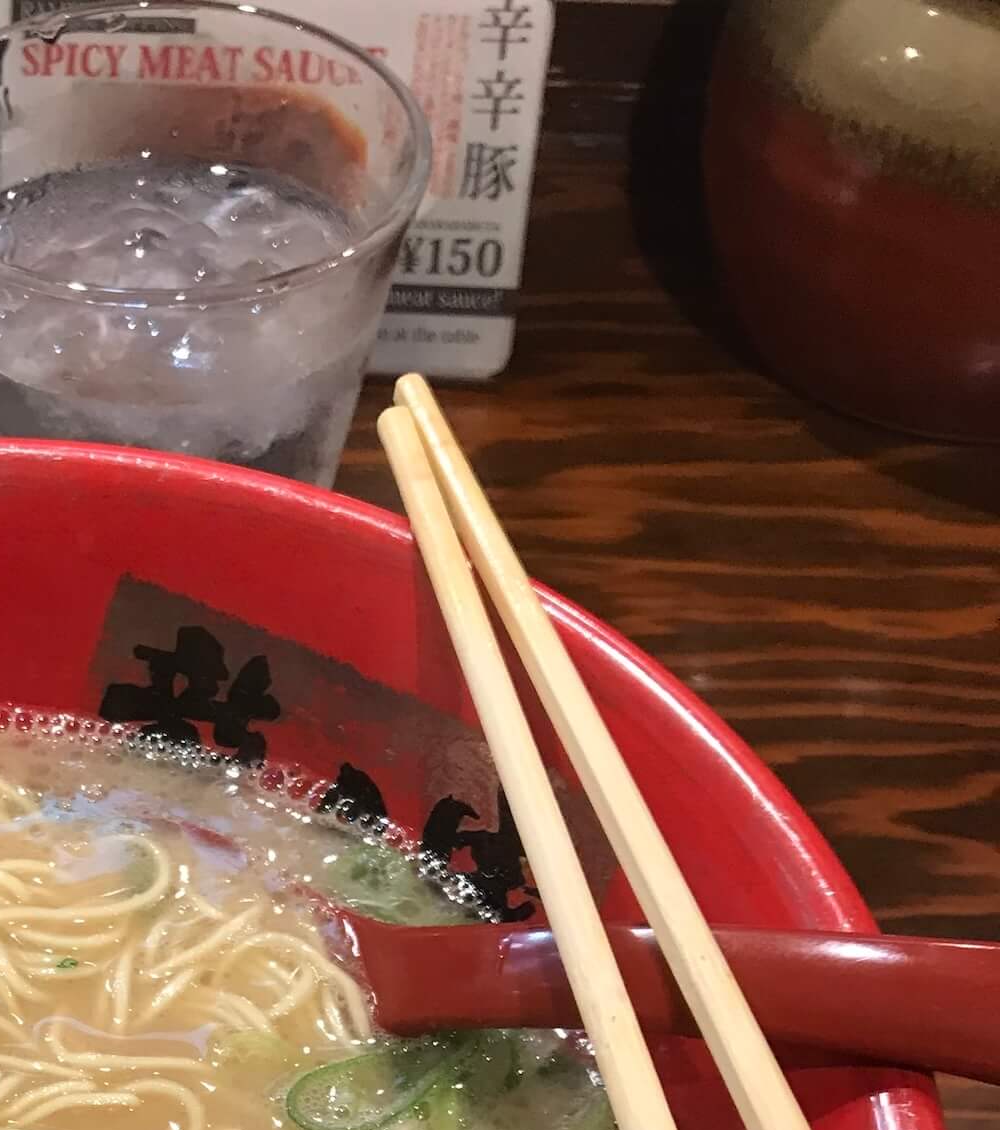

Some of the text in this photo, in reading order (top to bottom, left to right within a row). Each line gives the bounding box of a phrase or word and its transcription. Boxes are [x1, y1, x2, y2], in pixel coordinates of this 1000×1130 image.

[22, 44, 388, 86] SPICY MEAT SAUCE
[459, 0, 533, 200] 辛辛豚
[400, 236, 503, 278] ¥150
